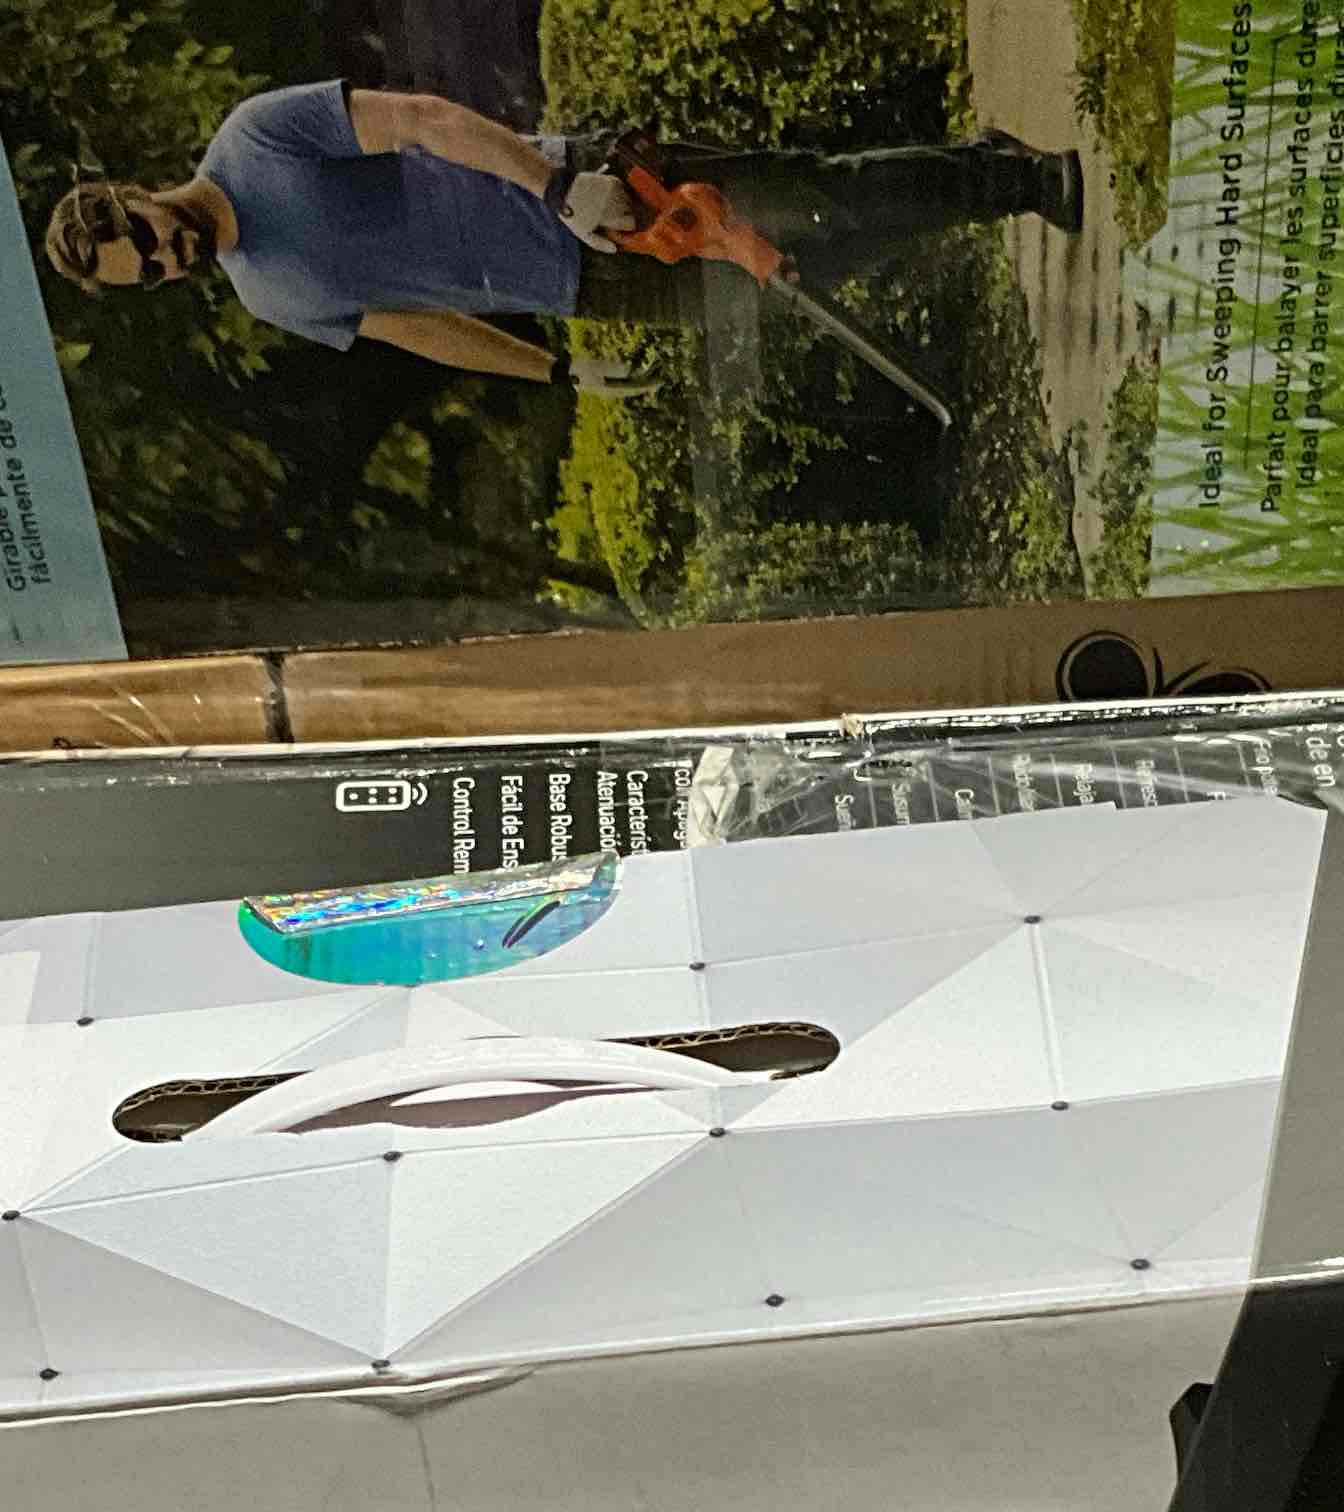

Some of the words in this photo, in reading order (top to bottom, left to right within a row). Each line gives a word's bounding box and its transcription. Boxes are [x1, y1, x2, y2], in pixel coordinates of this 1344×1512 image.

[1221, 1, 1251, 140] Surfaces
[1283, 78, 1314, 197] surfaces
[1216, 152, 1242, 225] Hard
[1280, 205, 1303, 244] les
[1206, 237, 1241, 382] Sweeping
[1272, 253, 1305, 351] balayer
[1306, 271, 1334, 352] barrer
[1203, 393, 1226, 431] for
[1271, 362, 1296, 421] pour
[1305, 362, 1330, 418] para
[1199, 444, 1223, 508] Ideal
[1260, 431, 1286, 511] Parfait
[1294, 427, 1319, 487] Ideal
[453, 776, 476, 838] Control
[501, 775, 523, 813] Fácil
[549, 772, 571, 812] Base
[502, 814, 523, 836] de
